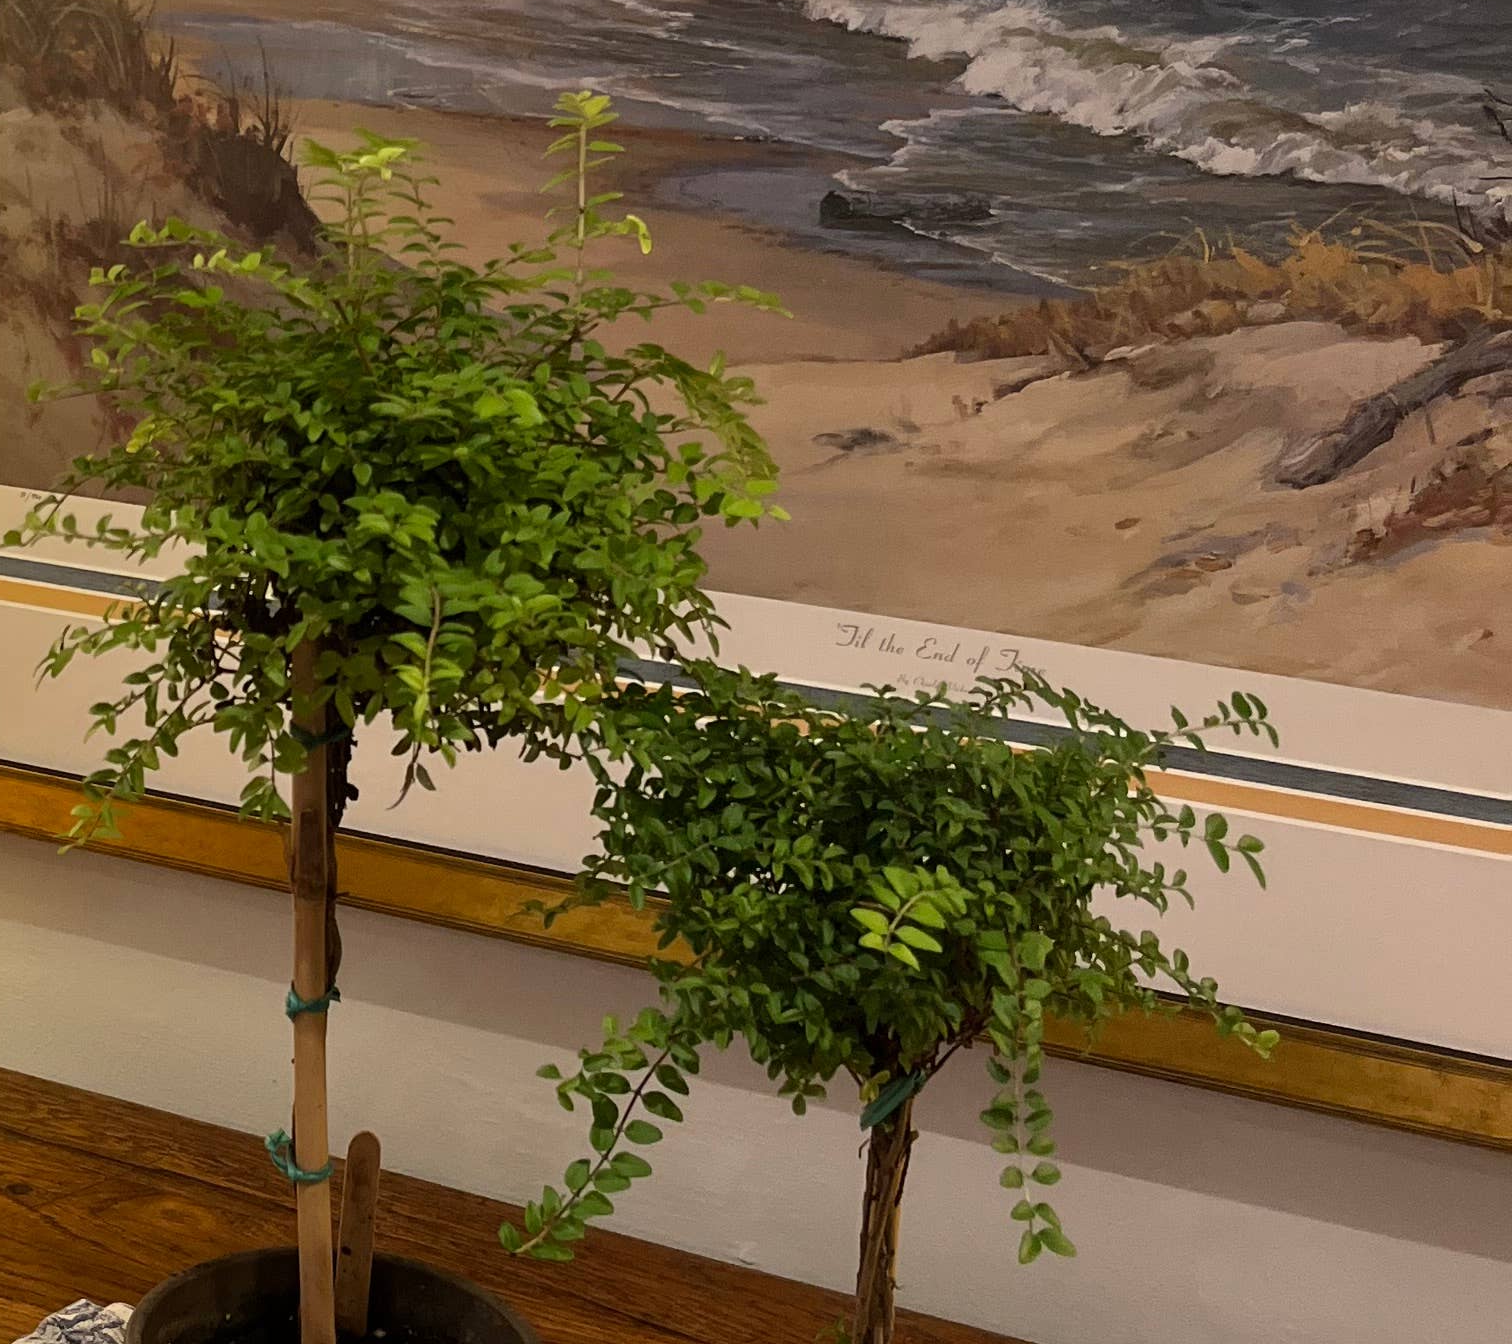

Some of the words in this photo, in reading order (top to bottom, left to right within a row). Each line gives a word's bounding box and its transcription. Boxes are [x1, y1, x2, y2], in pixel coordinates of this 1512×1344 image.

[878, 633, 905, 655] the
[915, 637, 960, 663] End
[966, 646, 990, 673] of
